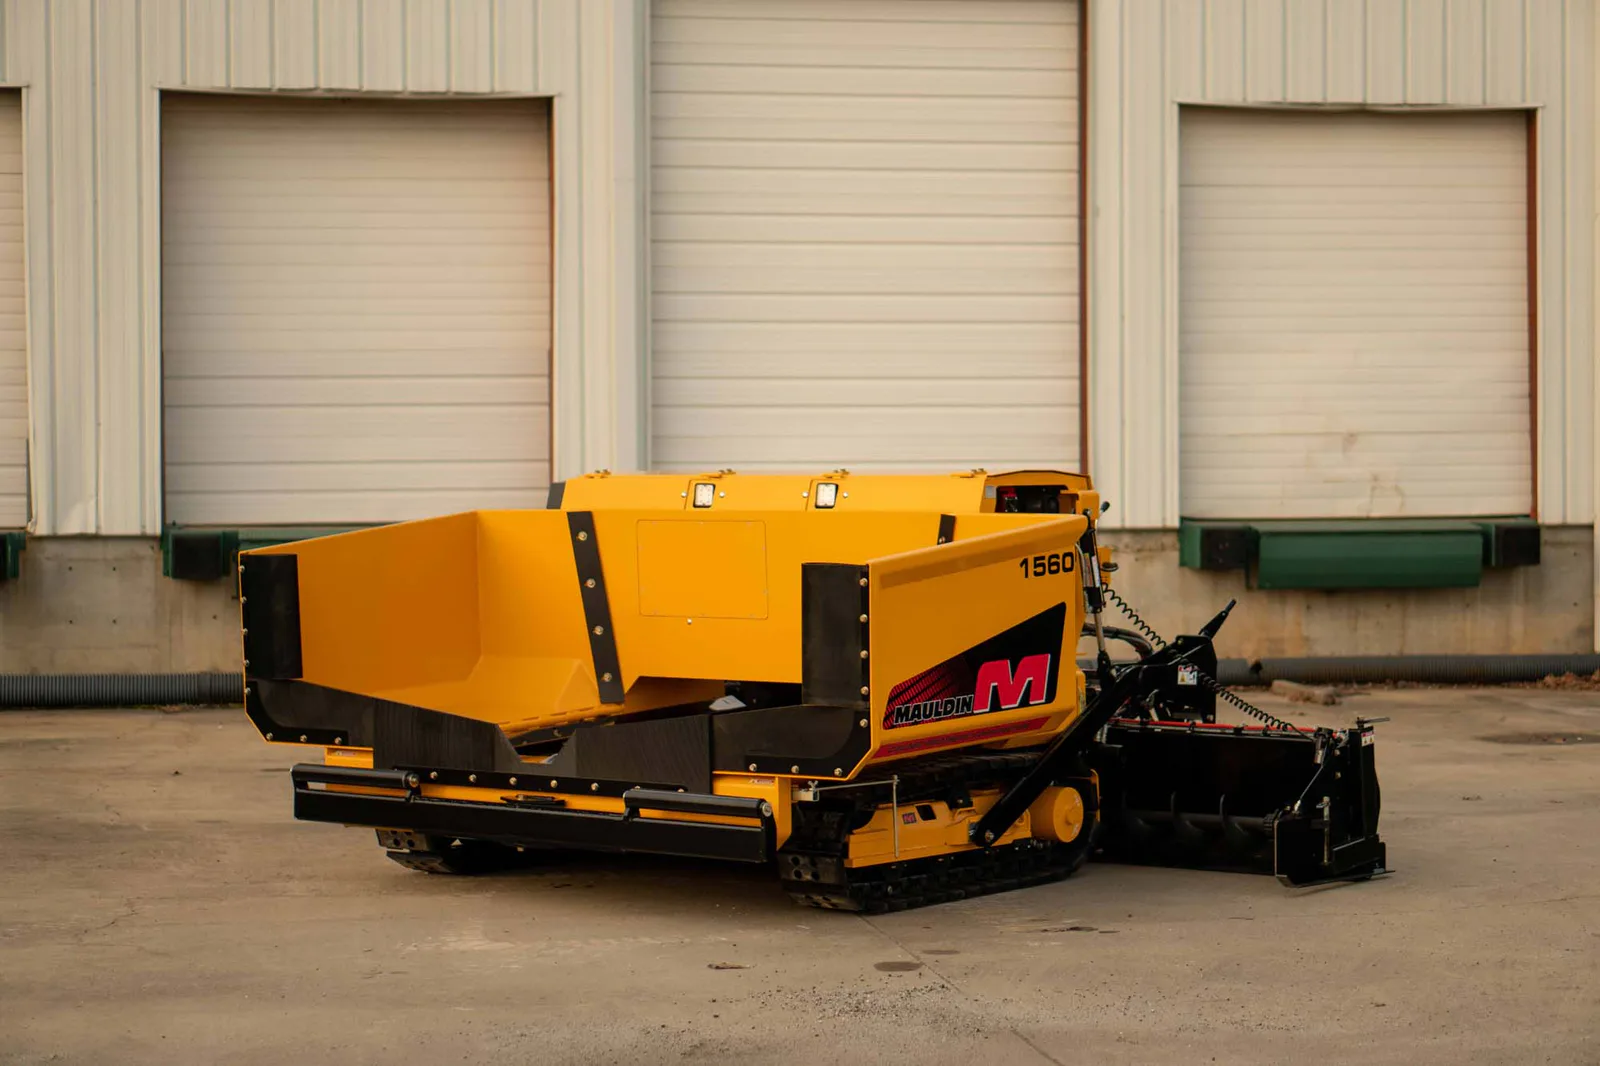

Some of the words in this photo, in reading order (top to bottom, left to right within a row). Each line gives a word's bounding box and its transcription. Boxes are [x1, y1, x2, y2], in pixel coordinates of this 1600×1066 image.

[1019, 552, 1075, 578] 1560
[973, 653, 1051, 713] M
[893, 694, 974, 725] MAULDIN
